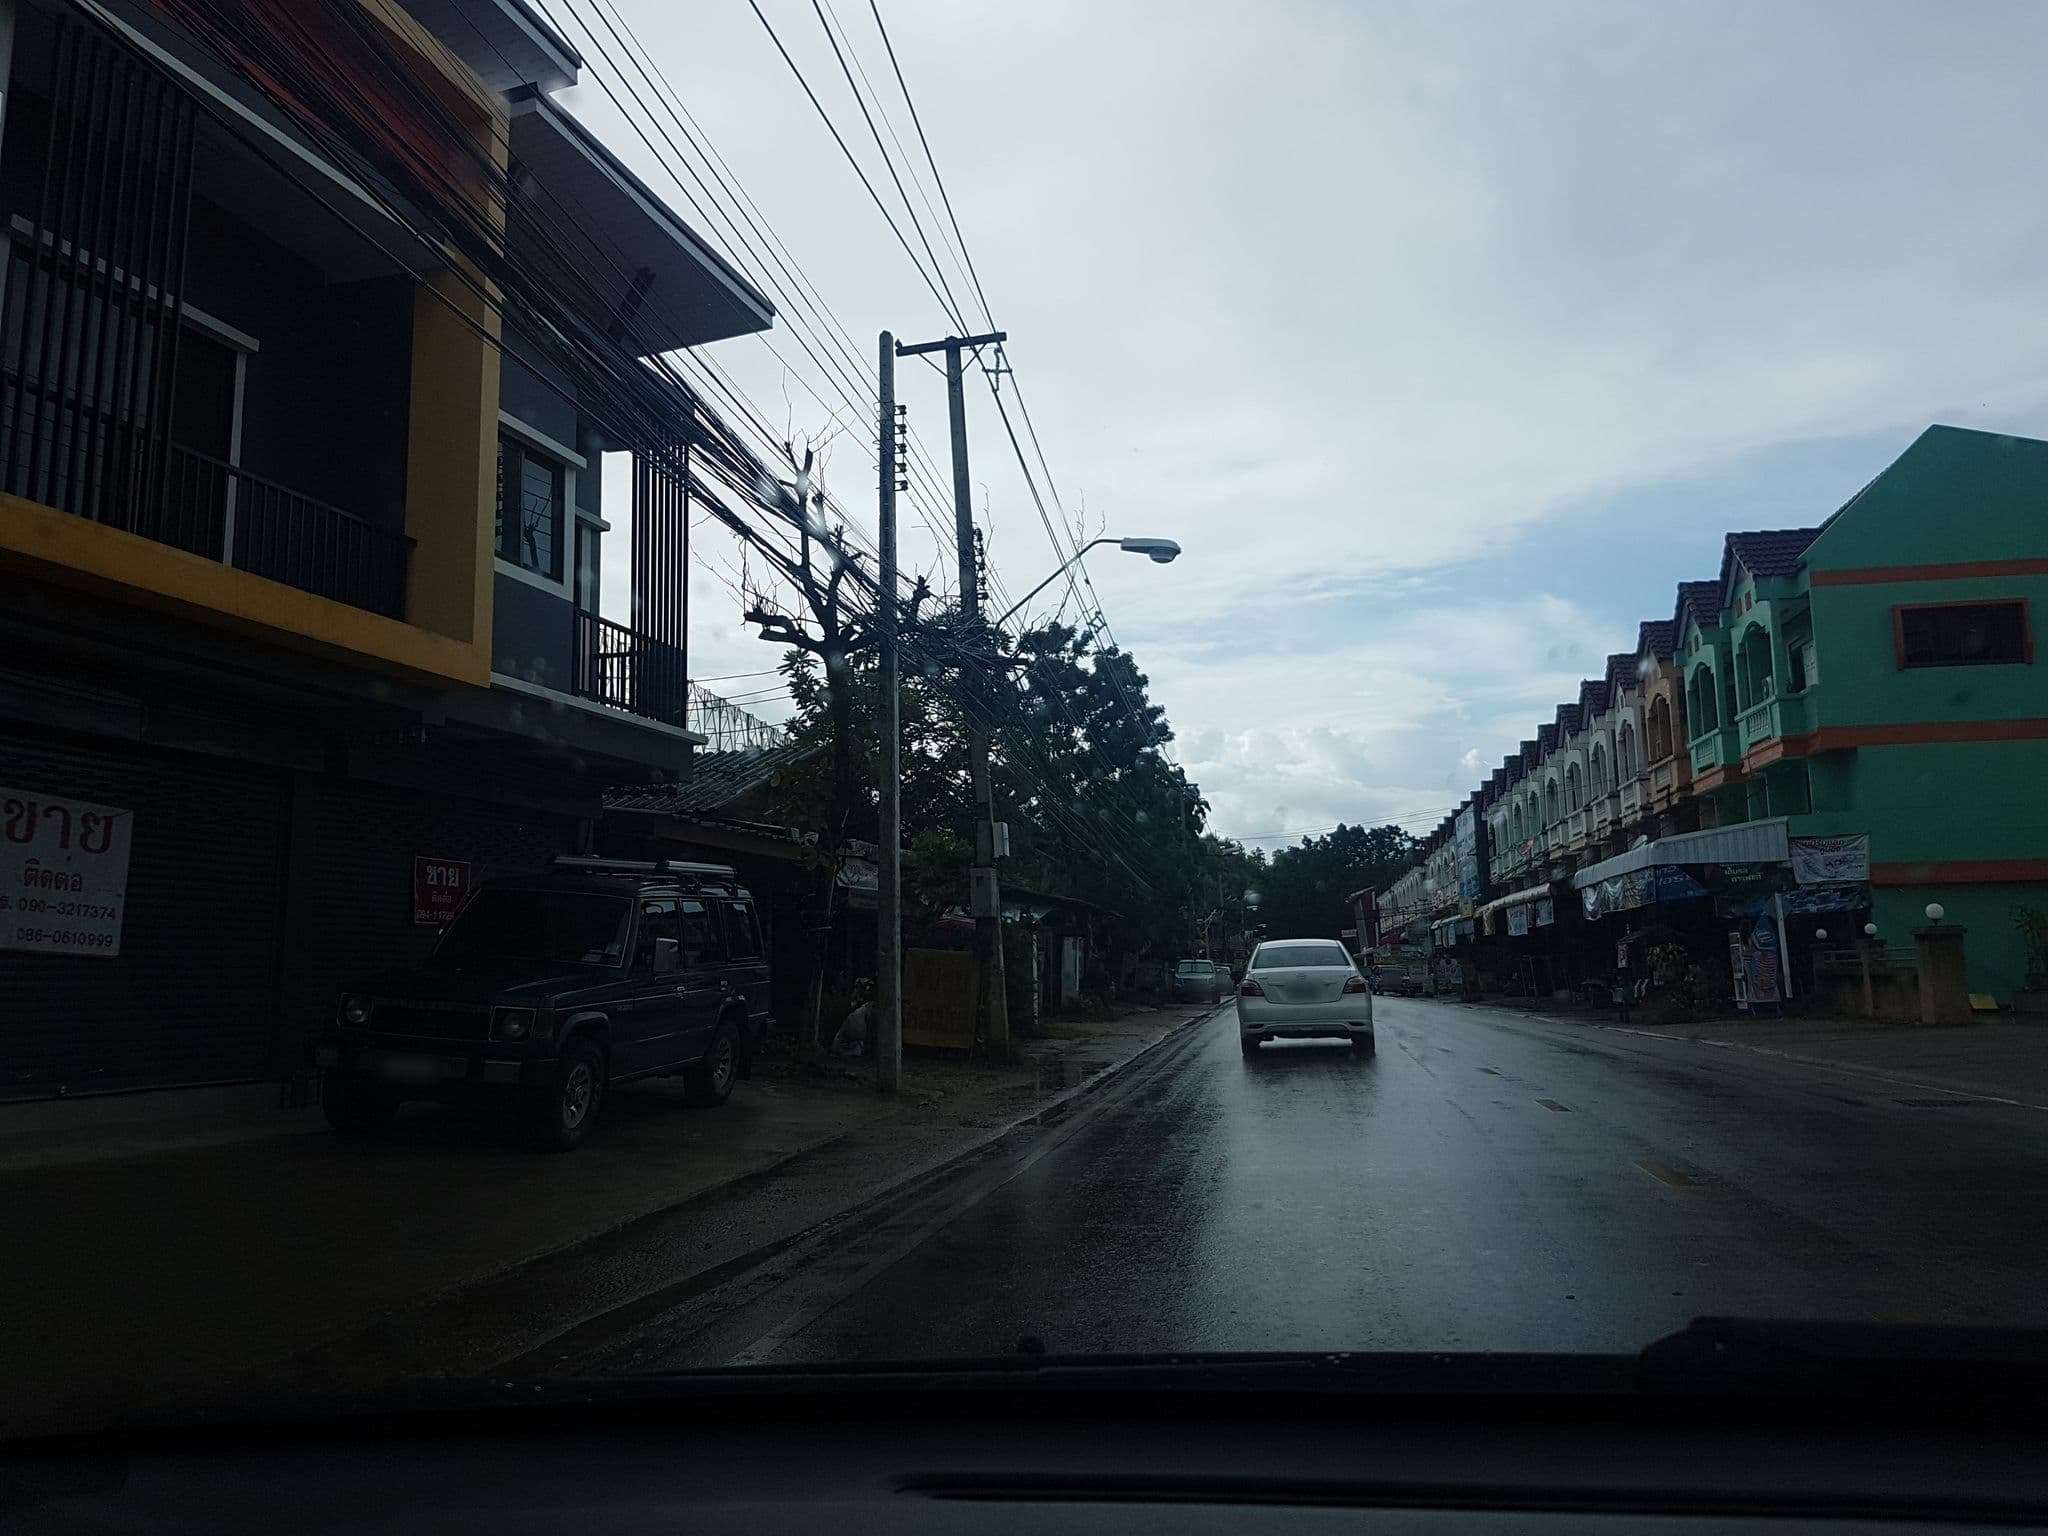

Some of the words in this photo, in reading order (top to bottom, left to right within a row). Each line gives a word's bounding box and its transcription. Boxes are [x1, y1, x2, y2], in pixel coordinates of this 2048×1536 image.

[4, 798, 113, 854] ขาย
[23, 857, 83, 892] ติดต่อ
[426, 865, 459, 887] ขาย
[16, 927, 113, 947] 086-0610999
